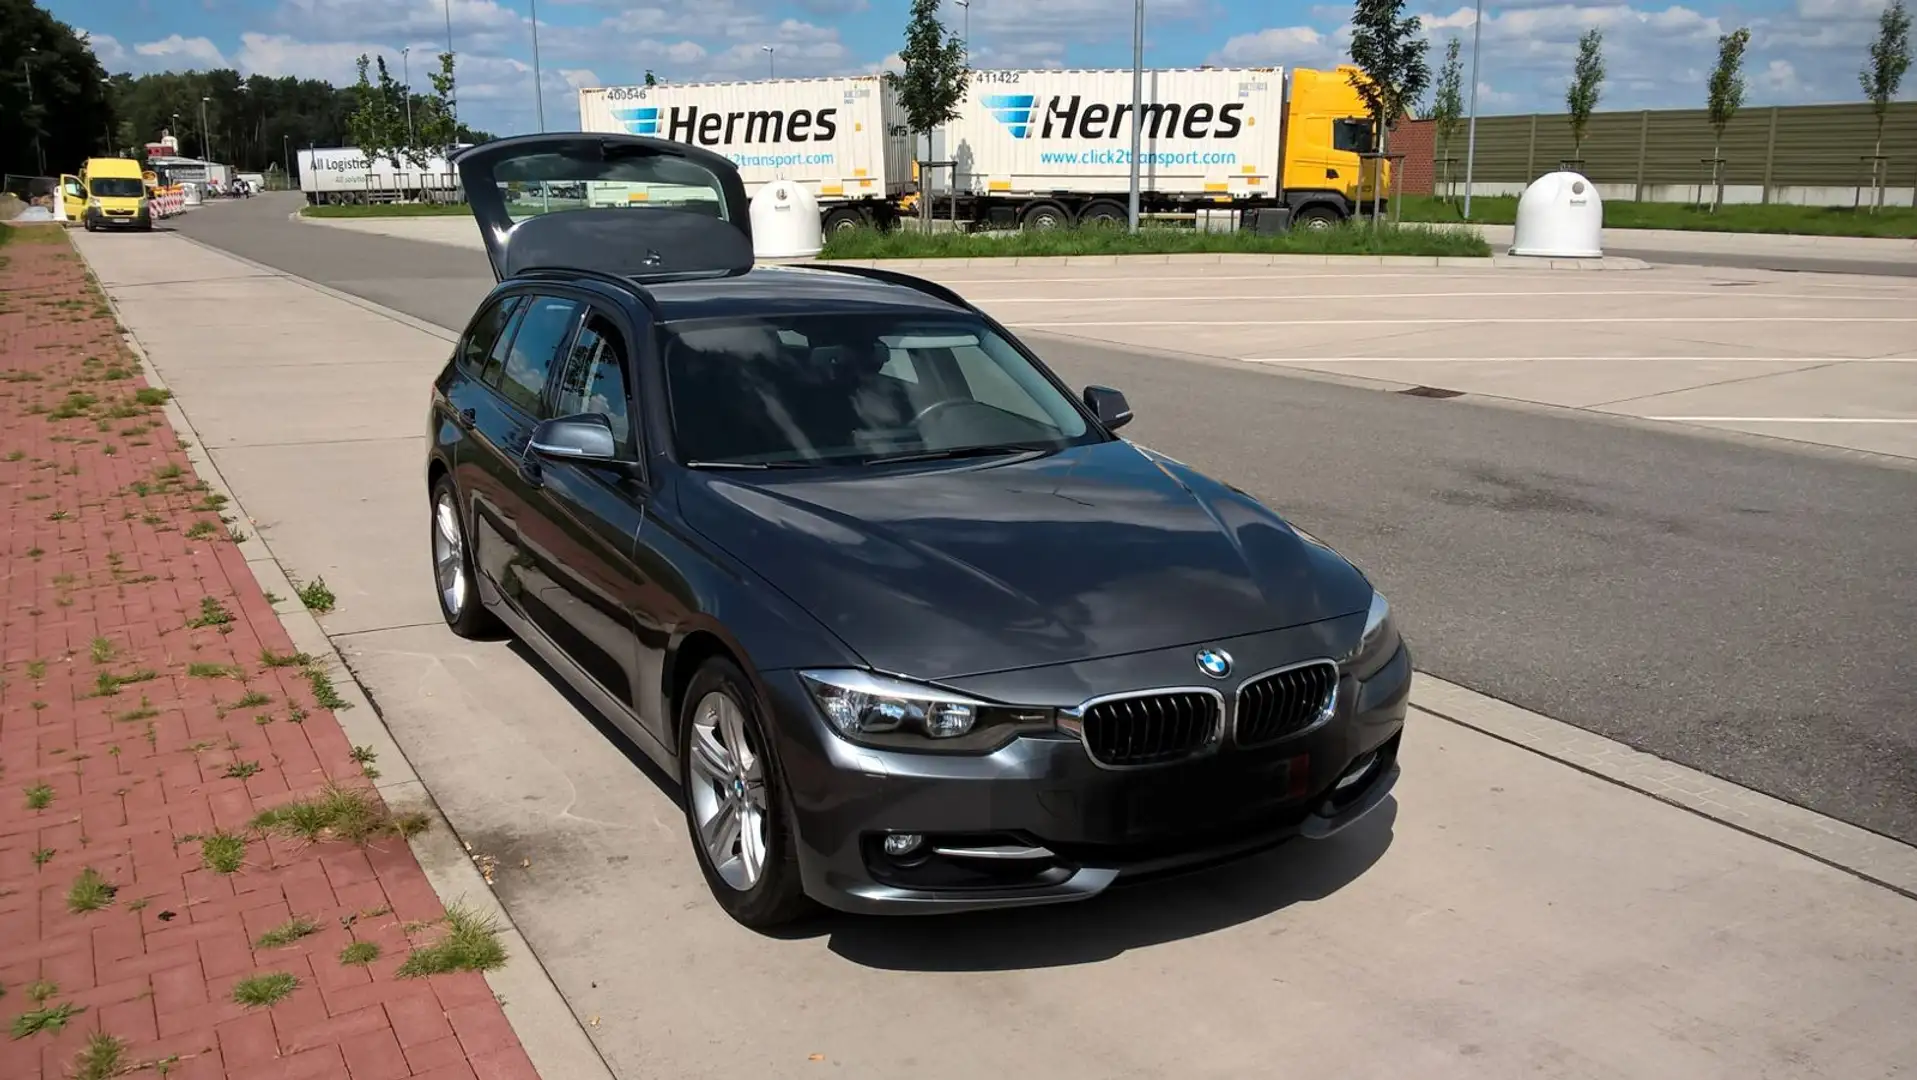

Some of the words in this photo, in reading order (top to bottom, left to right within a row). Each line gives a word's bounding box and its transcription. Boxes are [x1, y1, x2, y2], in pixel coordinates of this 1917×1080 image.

[976, 72, 1020, 84] 411422
[607, 87, 647, 101] 400546
[668, 105, 837, 146] Hermes
[1041, 95, 1244, 139] Hermes
[1040, 148, 1236, 168] www.click2tansport.com
